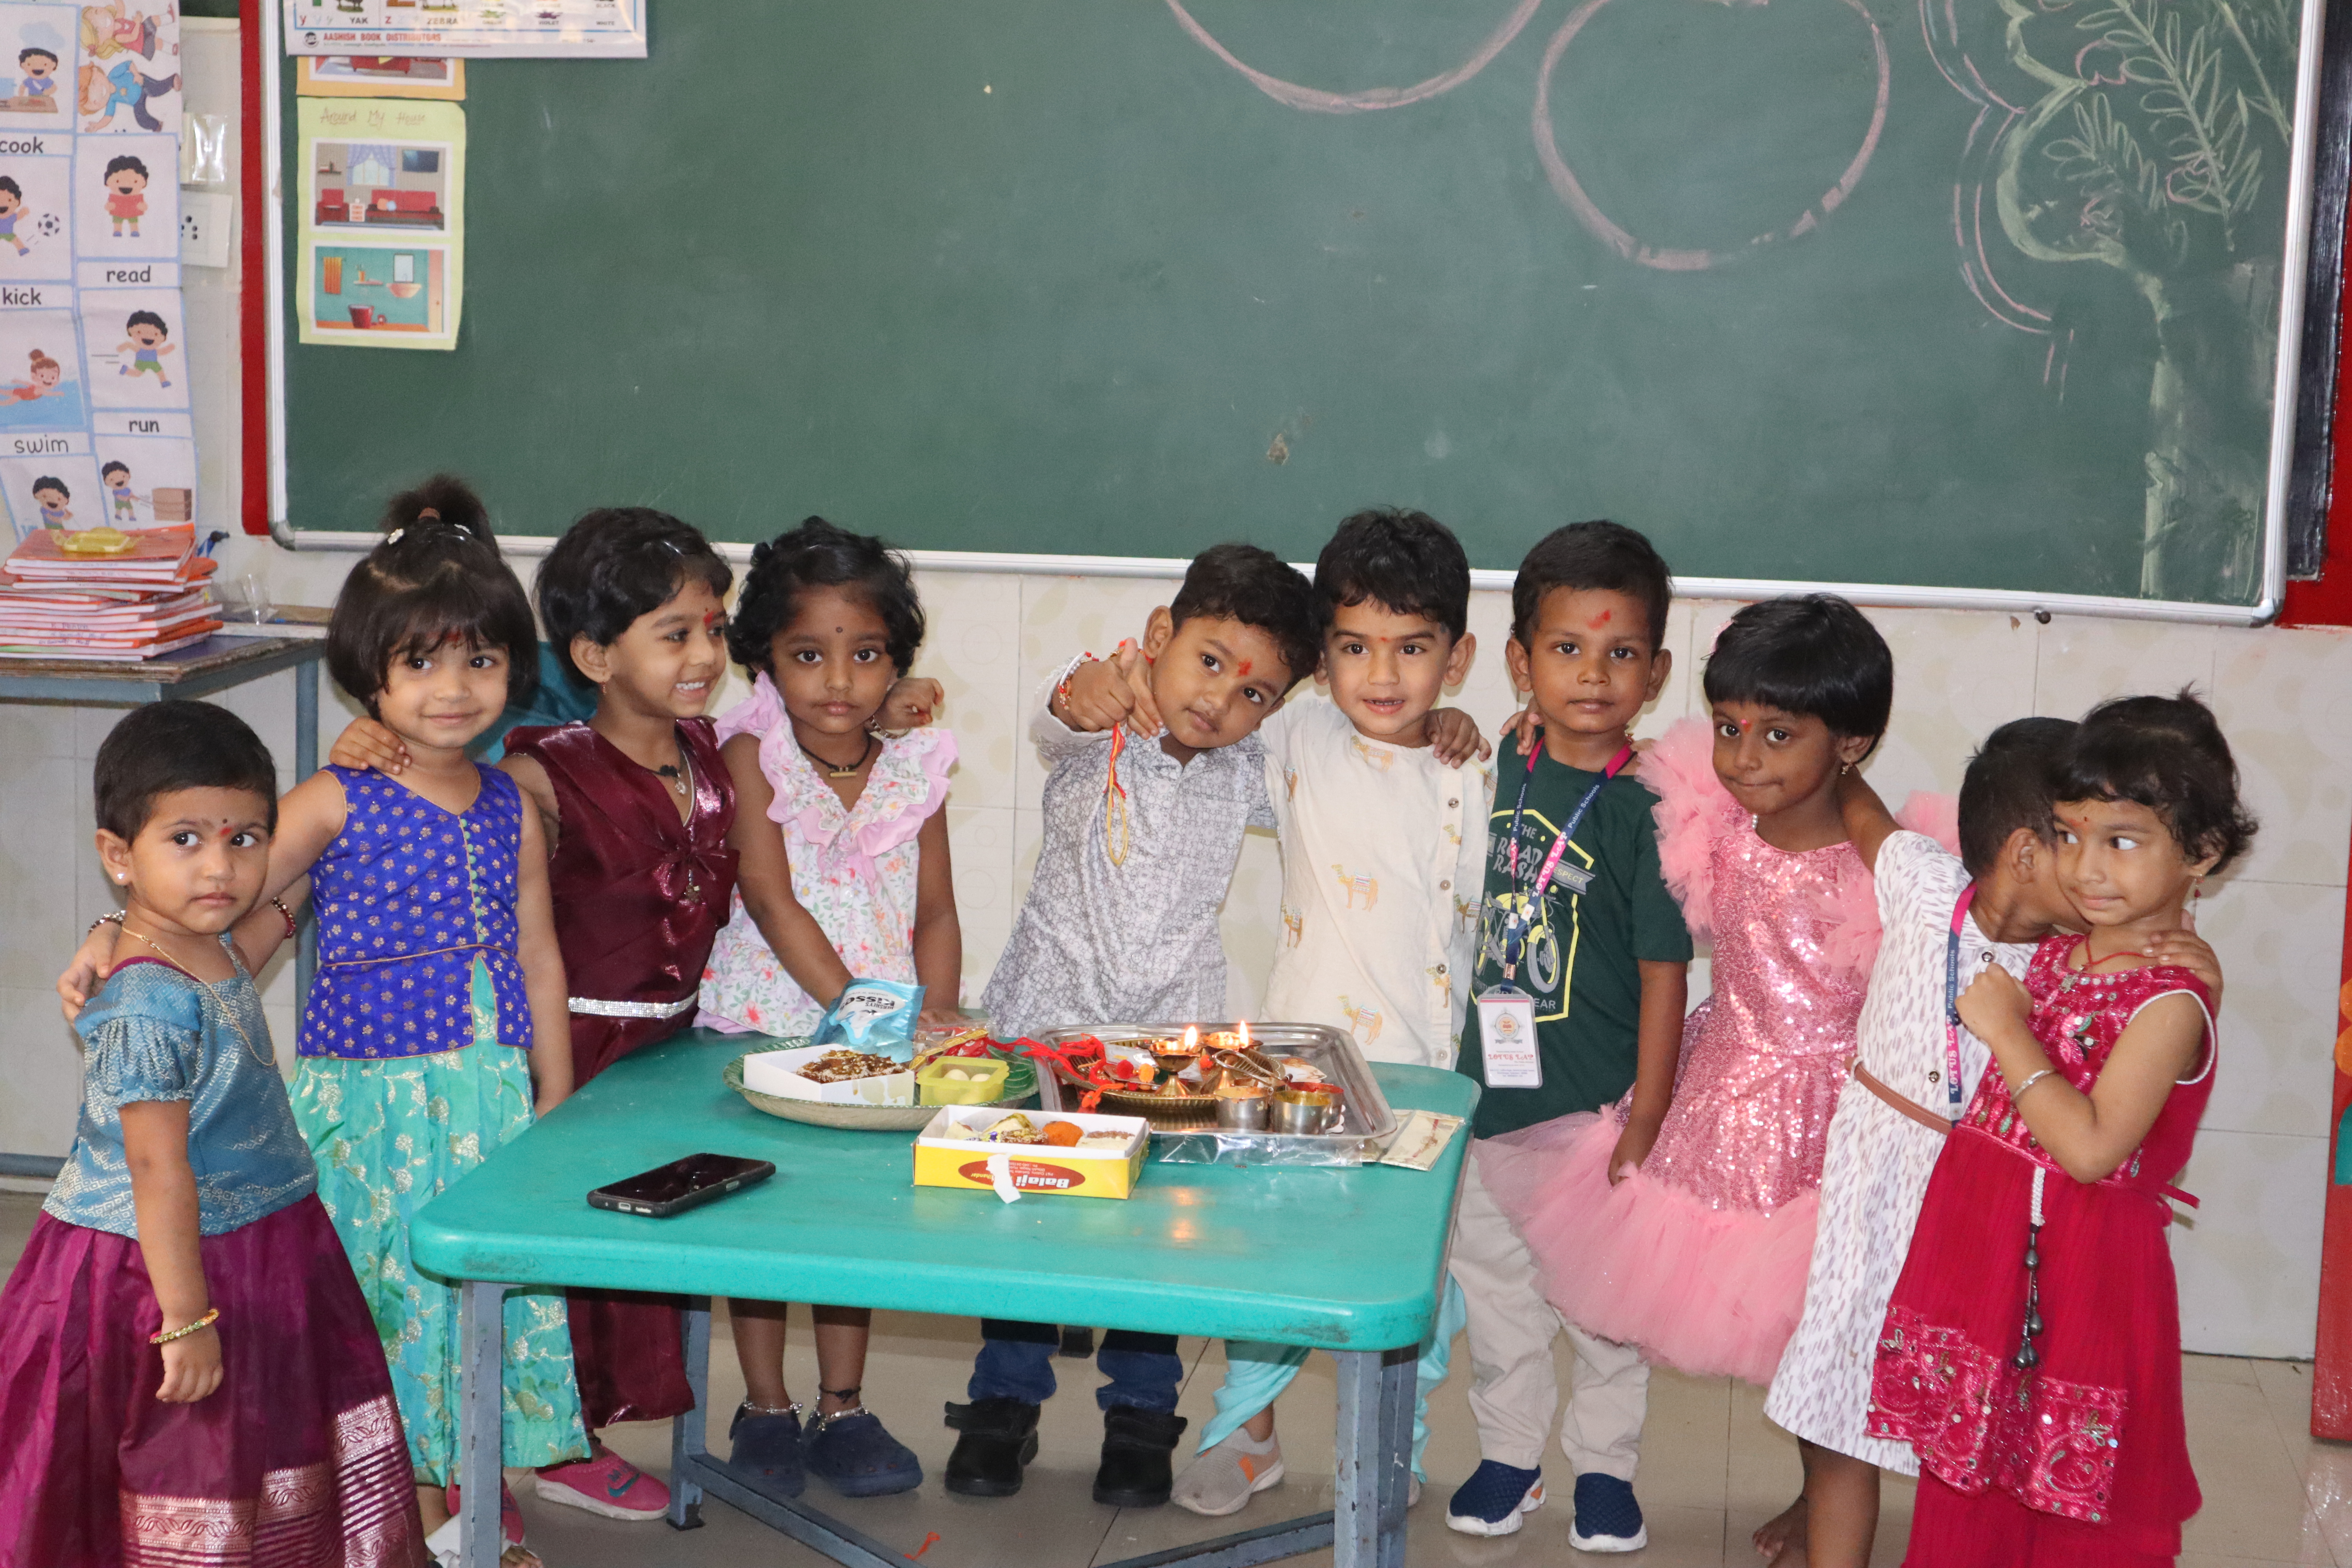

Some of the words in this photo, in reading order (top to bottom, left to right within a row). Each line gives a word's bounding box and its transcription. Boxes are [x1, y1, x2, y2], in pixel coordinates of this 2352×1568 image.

[324, 33, 356, 41] AASHISH
[386, 33, 441, 42] DISTRIBUTORS
[320, 107, 357, 124] Around
[367, 110, 385, 130] My
[0, 136, 43, 153] cook
[106, 265, 151, 282] read
[3, 287, 42, 305] kick
[129, 420, 160, 432] run
[15, 435, 69, 453] swim
[1517, 783, 1527, 809] Schools
[1532, 860, 1554, 897] LOTUS
[1551, 831, 1568, 857] LAP
[1568, 808, 1583, 828] Public
[1580, 784, 1600, 808] Schools
[1553, 866, 1584, 884] ESPECT
[1534, 998, 1556, 1009] EAR
[1946, 1014, 1955, 1047] LAP
[1948, 1050, 1959, 1094] LOTUS
[1015, 1174, 1070, 1188] Balaji
